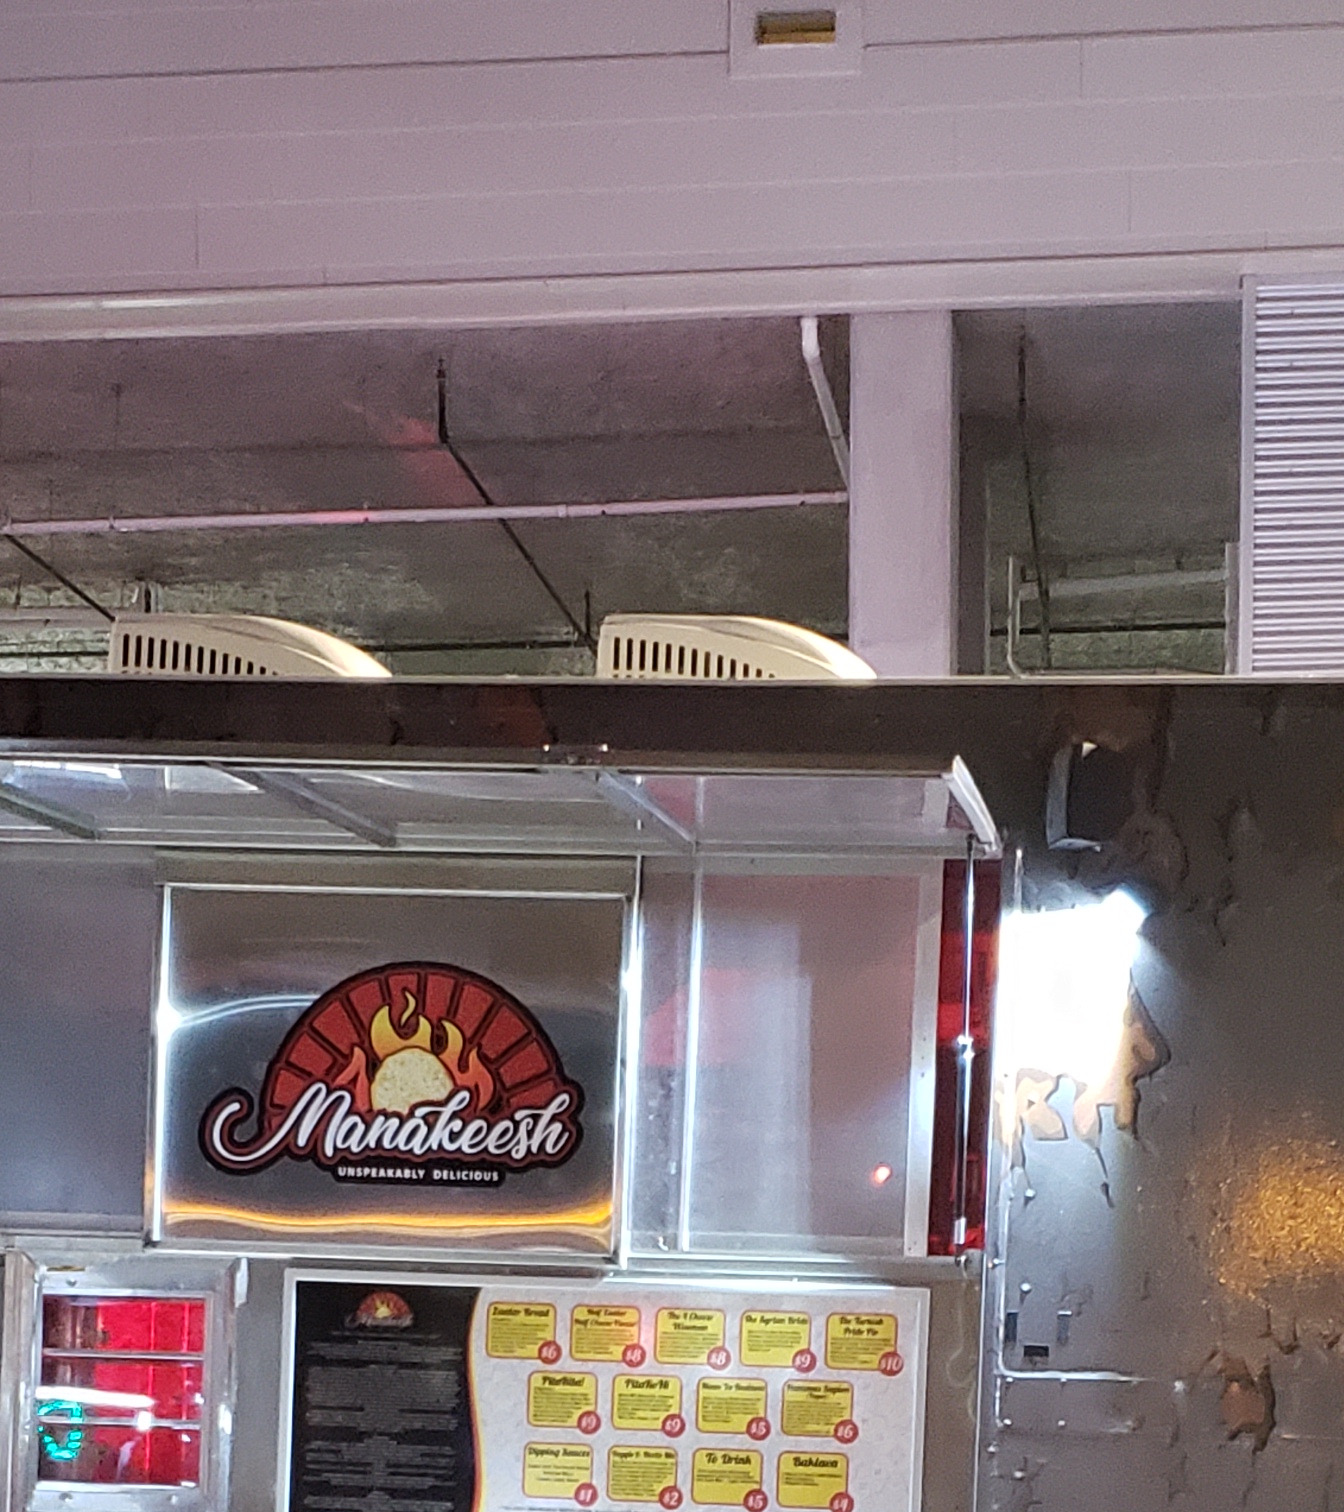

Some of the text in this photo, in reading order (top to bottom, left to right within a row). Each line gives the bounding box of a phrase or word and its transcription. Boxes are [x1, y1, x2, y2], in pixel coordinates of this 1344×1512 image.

[212, 1081, 571, 1162] Manakeesh
[337, 1166, 500, 1182] UNSPEAKABLY DELICIOUS
[794, 1353, 811, 1367] $9
[880, 1355, 902, 1372] $10
